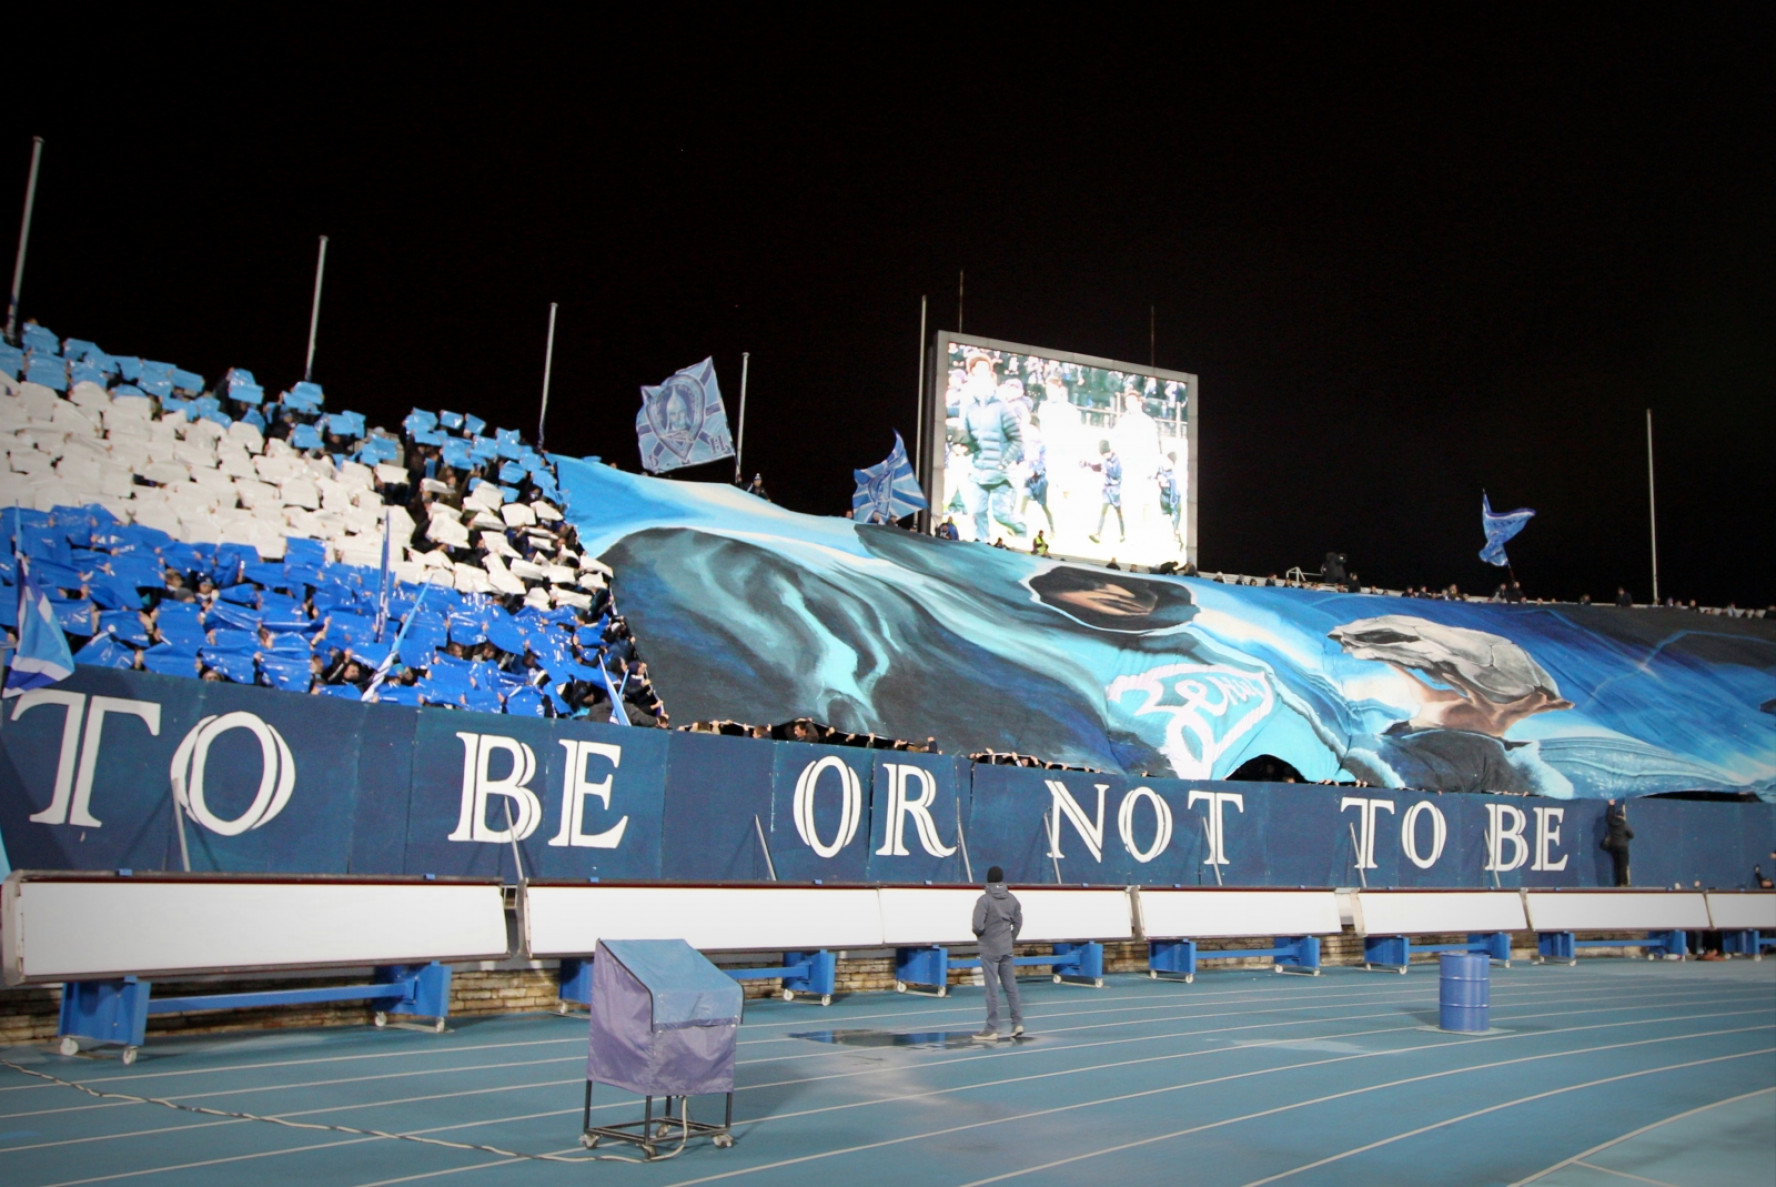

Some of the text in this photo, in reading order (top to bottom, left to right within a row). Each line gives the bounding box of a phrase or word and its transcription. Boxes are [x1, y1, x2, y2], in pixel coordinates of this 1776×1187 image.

[10, 688, 1569, 872] TO BE OR NOT TO BE
